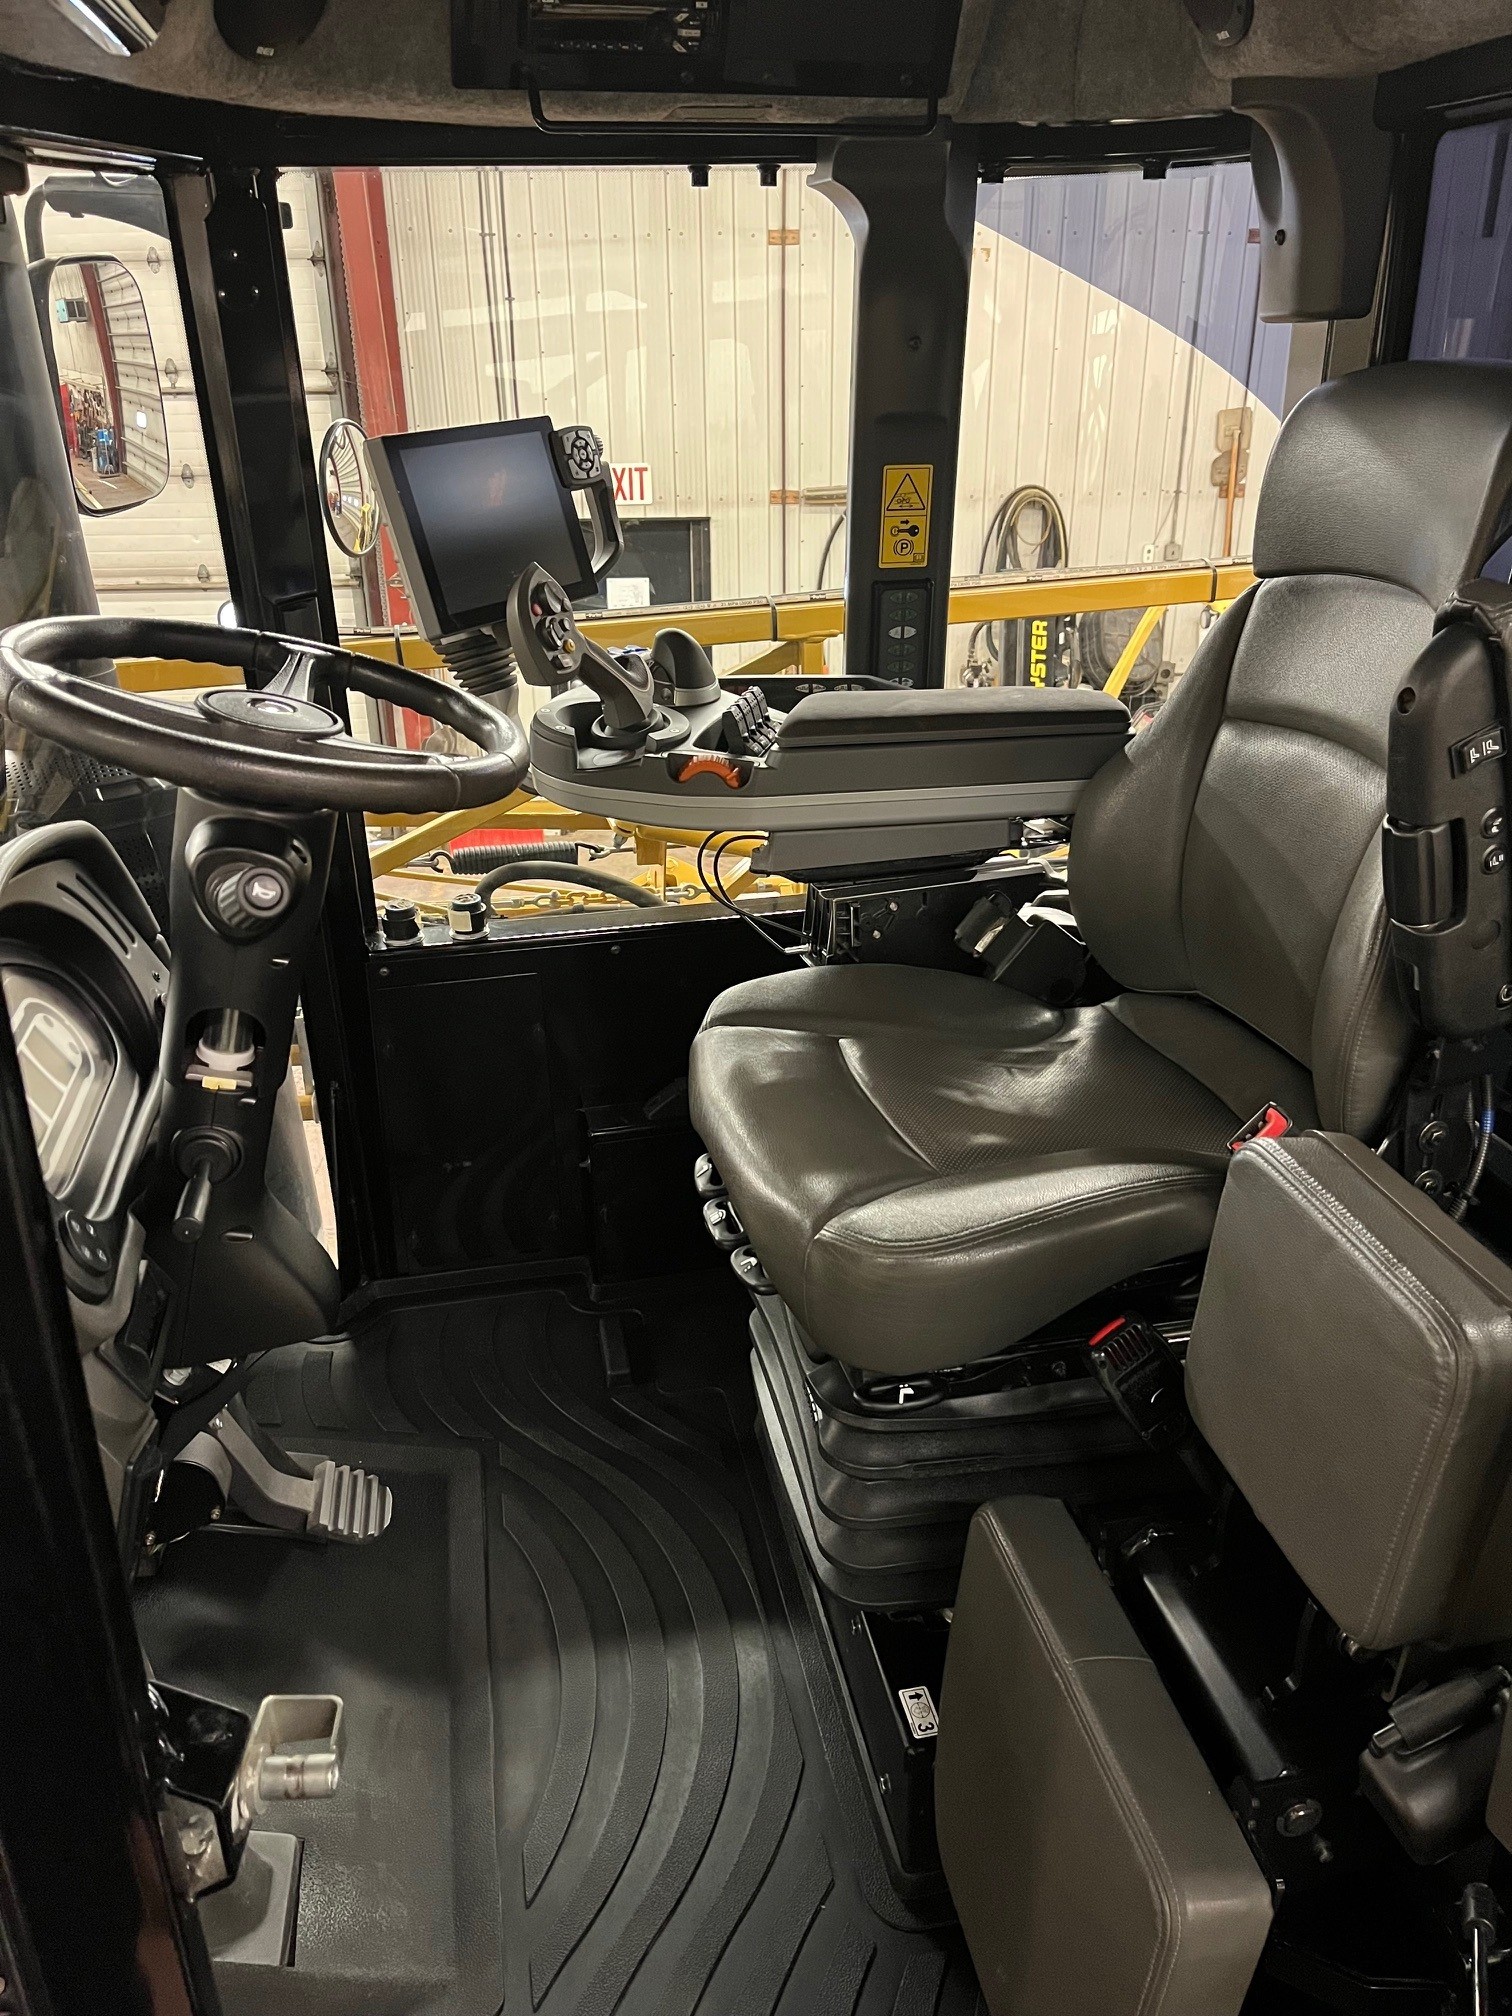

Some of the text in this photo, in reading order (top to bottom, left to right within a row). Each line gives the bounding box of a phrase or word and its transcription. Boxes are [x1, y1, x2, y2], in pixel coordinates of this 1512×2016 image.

[612, 467, 648, 500] XIT
[900, 542, 908, 553] P
[1030, 620, 1048, 688] YSTER
[918, 1721, 935, 1732] 3
